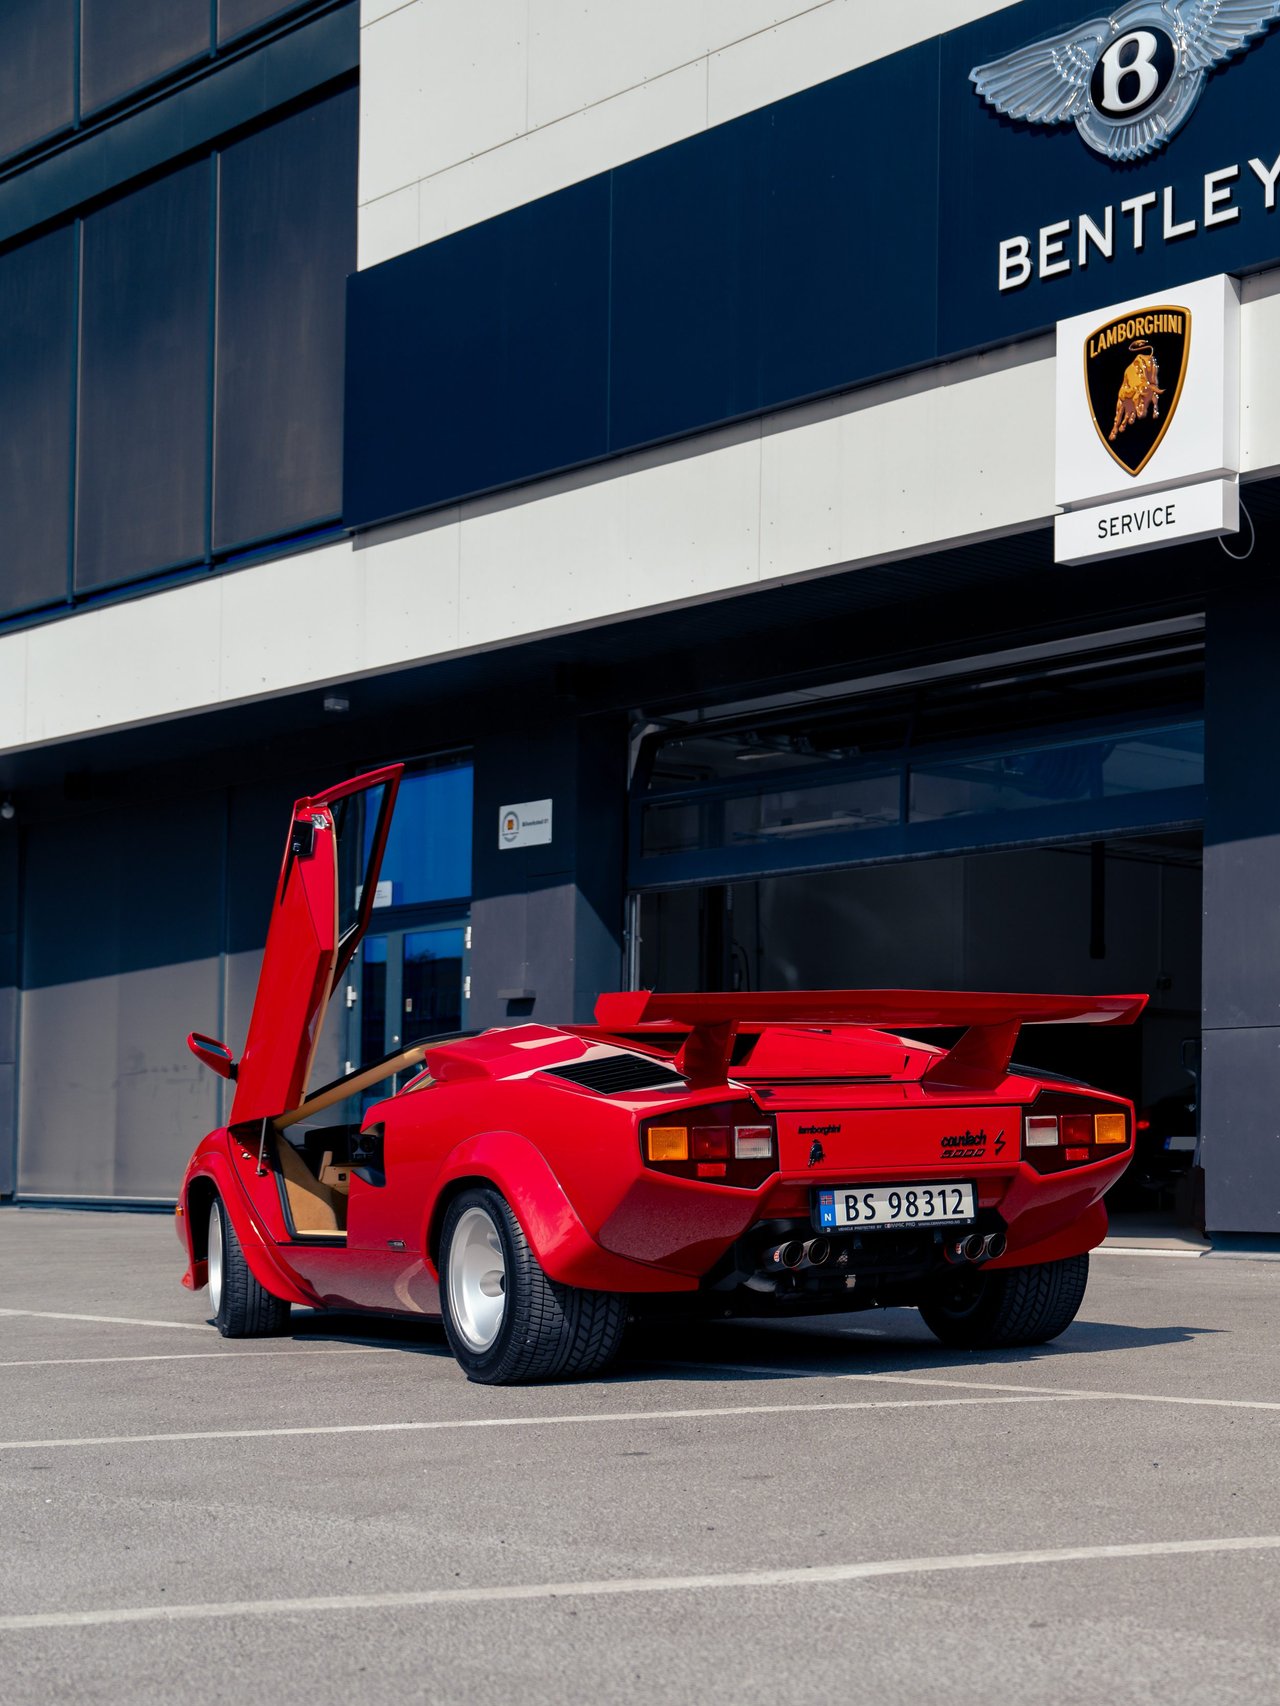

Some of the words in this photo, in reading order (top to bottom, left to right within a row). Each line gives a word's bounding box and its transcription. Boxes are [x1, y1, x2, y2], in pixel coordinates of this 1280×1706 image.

[1090, 314, 1182, 358] LAMBORGHINI
[1098, 504, 1176, 539] SERVICE
[798, 1124, 841, 1135] lamborghini
[940, 1148, 985, 1158] 5000
[844, 1193, 876, 1221] BS
[888, 1189, 964, 1219] 98312
[824, 1213, 831, 1221] N
